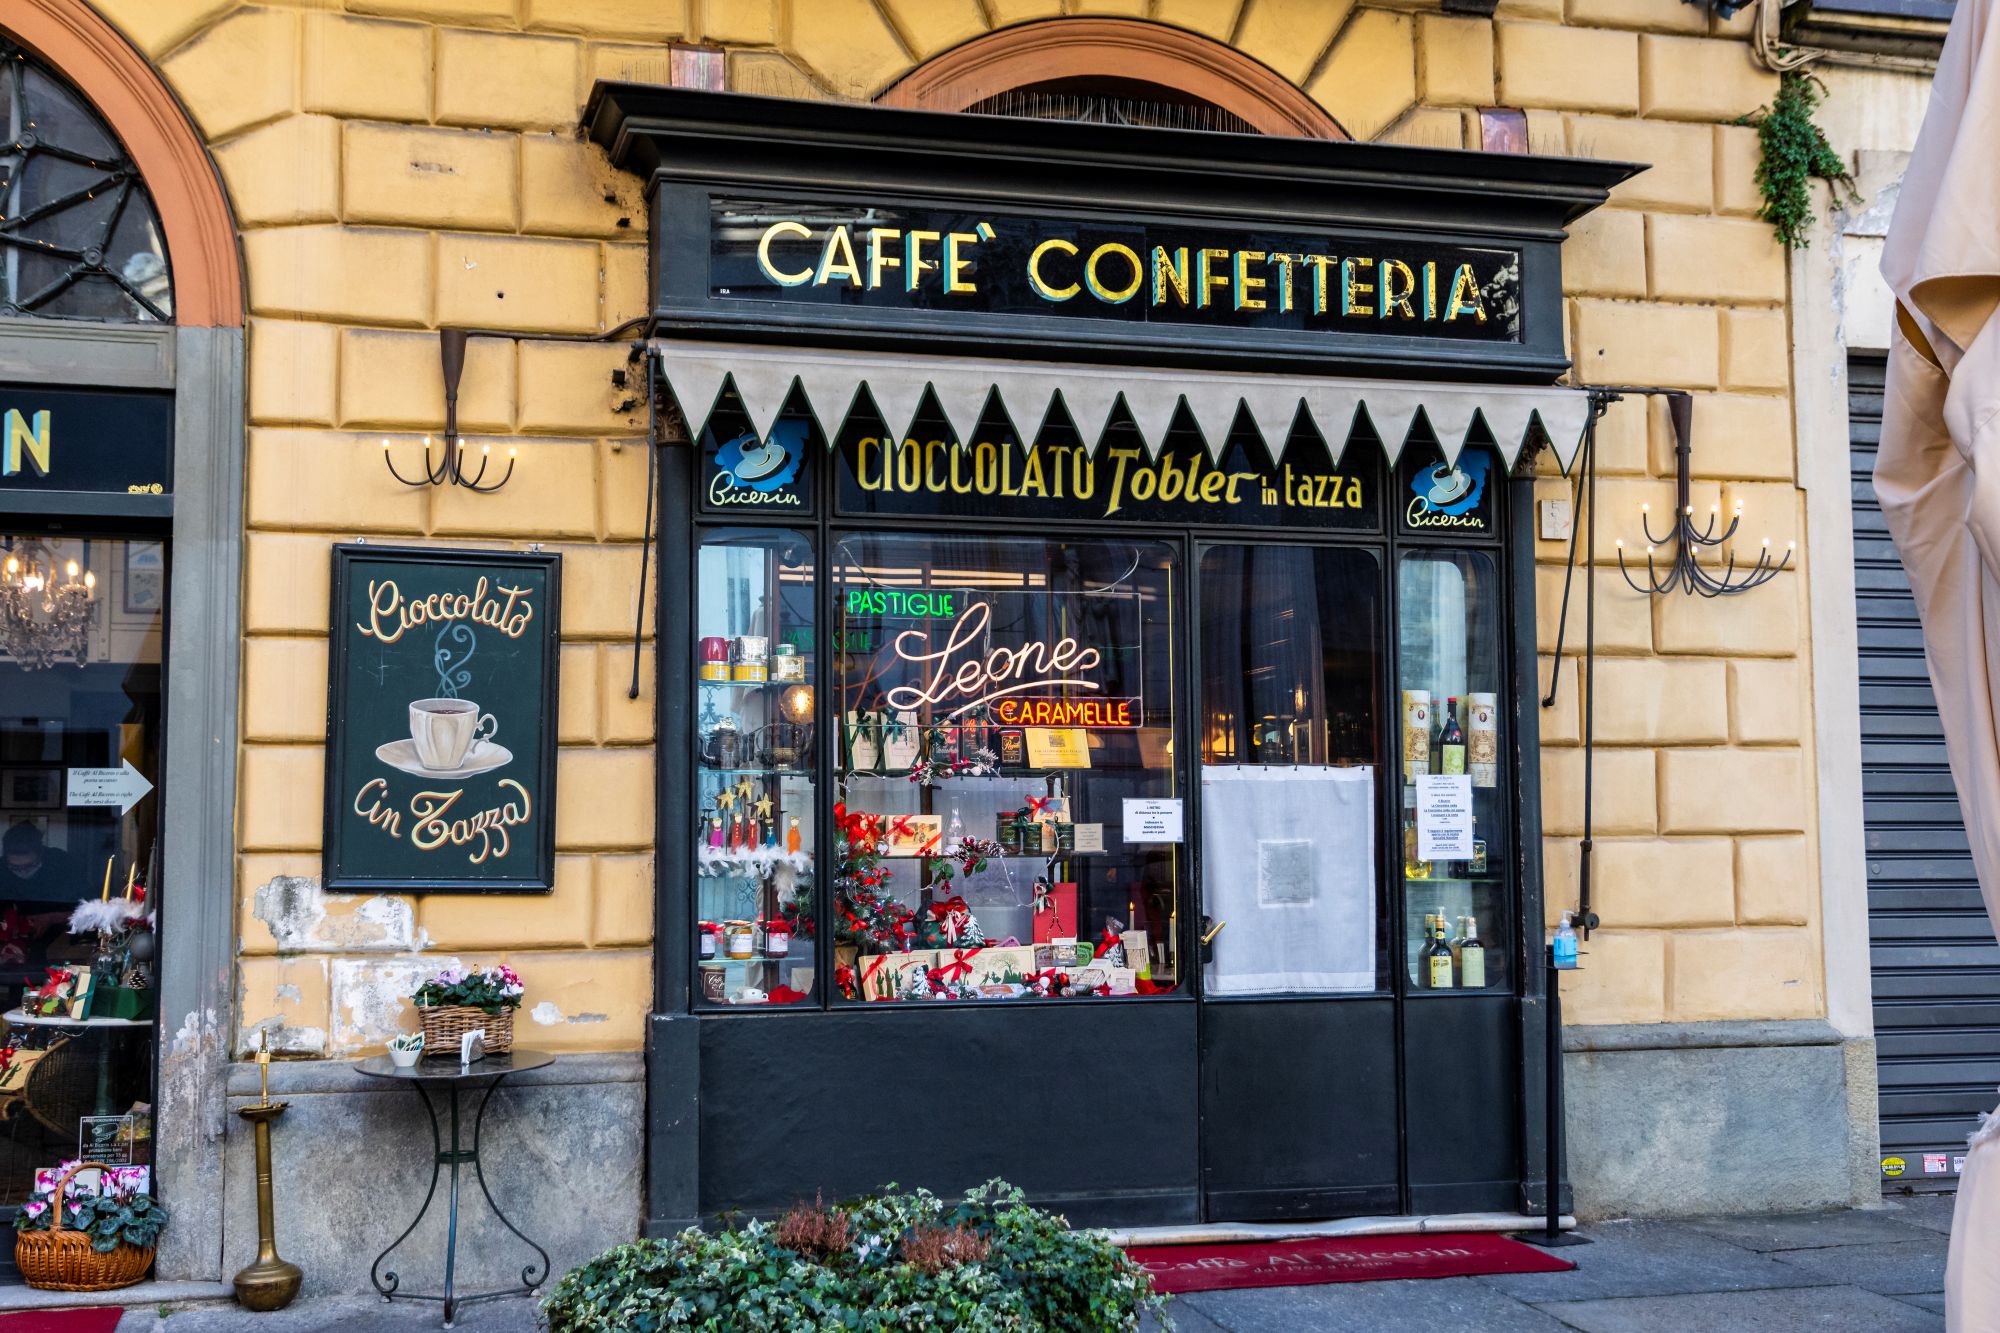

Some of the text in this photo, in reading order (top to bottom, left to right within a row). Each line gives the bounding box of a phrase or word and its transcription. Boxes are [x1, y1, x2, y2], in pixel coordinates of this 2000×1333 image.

[1027, 238, 1488, 322] CONFETTERIA
[3, 408, 50, 477] N
[709, 470, 801, 506] Bicerin
[857, 436, 1363, 519] CIOCCOLATO Tobler in tazza
[1406, 496, 1485, 529] Bicerin
[356, 575, 533, 643] Cioccolato
[887, 601, 1101, 711] Leone
[999, 700, 1130, 726] CARAMELLE
[410, 778, 532, 864] Tazza
[1320, 1248, 1473, 1262] Bicerin
